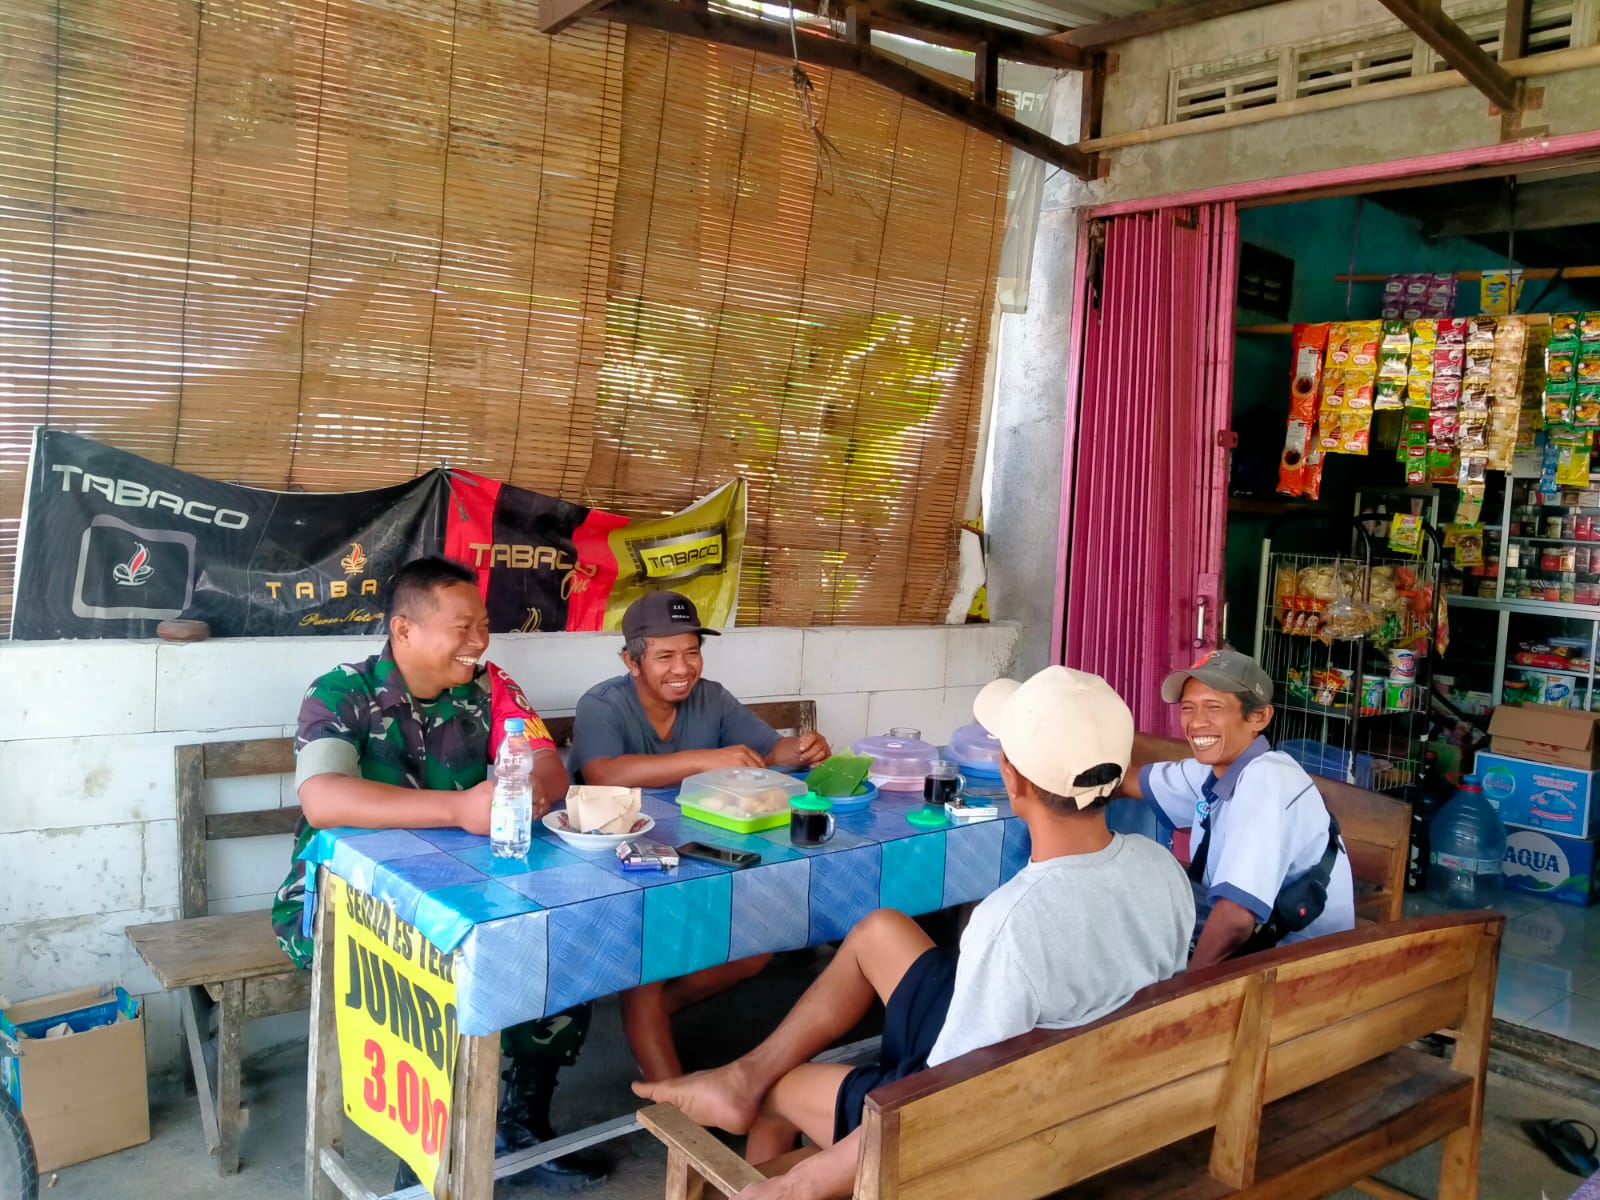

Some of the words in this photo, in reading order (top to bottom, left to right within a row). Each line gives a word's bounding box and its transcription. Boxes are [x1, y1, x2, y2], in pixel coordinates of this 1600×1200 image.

[52, 464, 250, 530] TABACO
[469, 543, 597, 577] TABACO
[647, 544, 719, 569] TABACO
[265, 577, 379, 600] TABA
[560, 570, 590, 601] One
[1502, 845, 1560, 873] AQUA
[393, 914, 413, 961] ES
